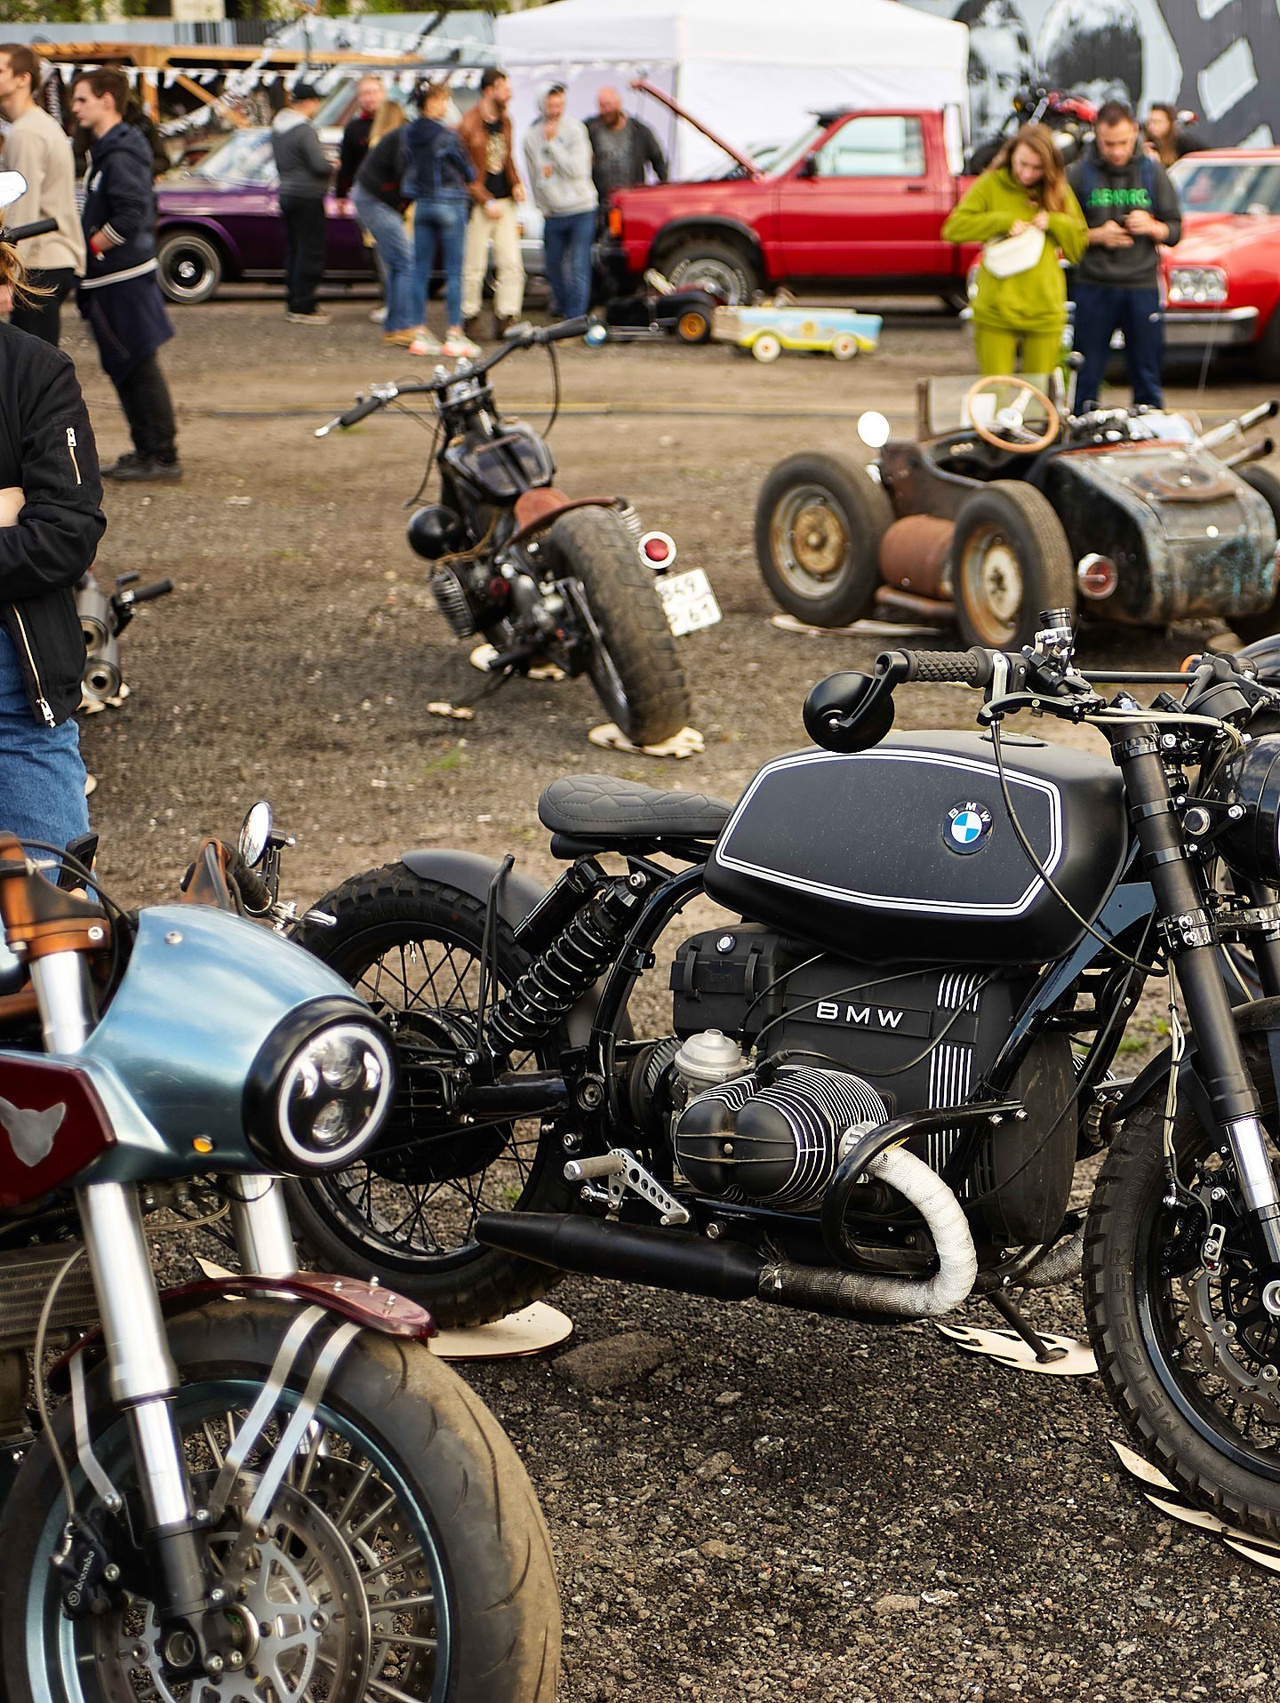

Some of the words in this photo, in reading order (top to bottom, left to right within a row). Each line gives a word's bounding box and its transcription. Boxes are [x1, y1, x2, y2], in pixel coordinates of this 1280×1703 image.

[948, 801, 991, 822] BMW
[816, 1001, 904, 1029] BMW
[1108, 1247, 1180, 1438] METZELER
[74, 1550, 95, 1591] brembo
